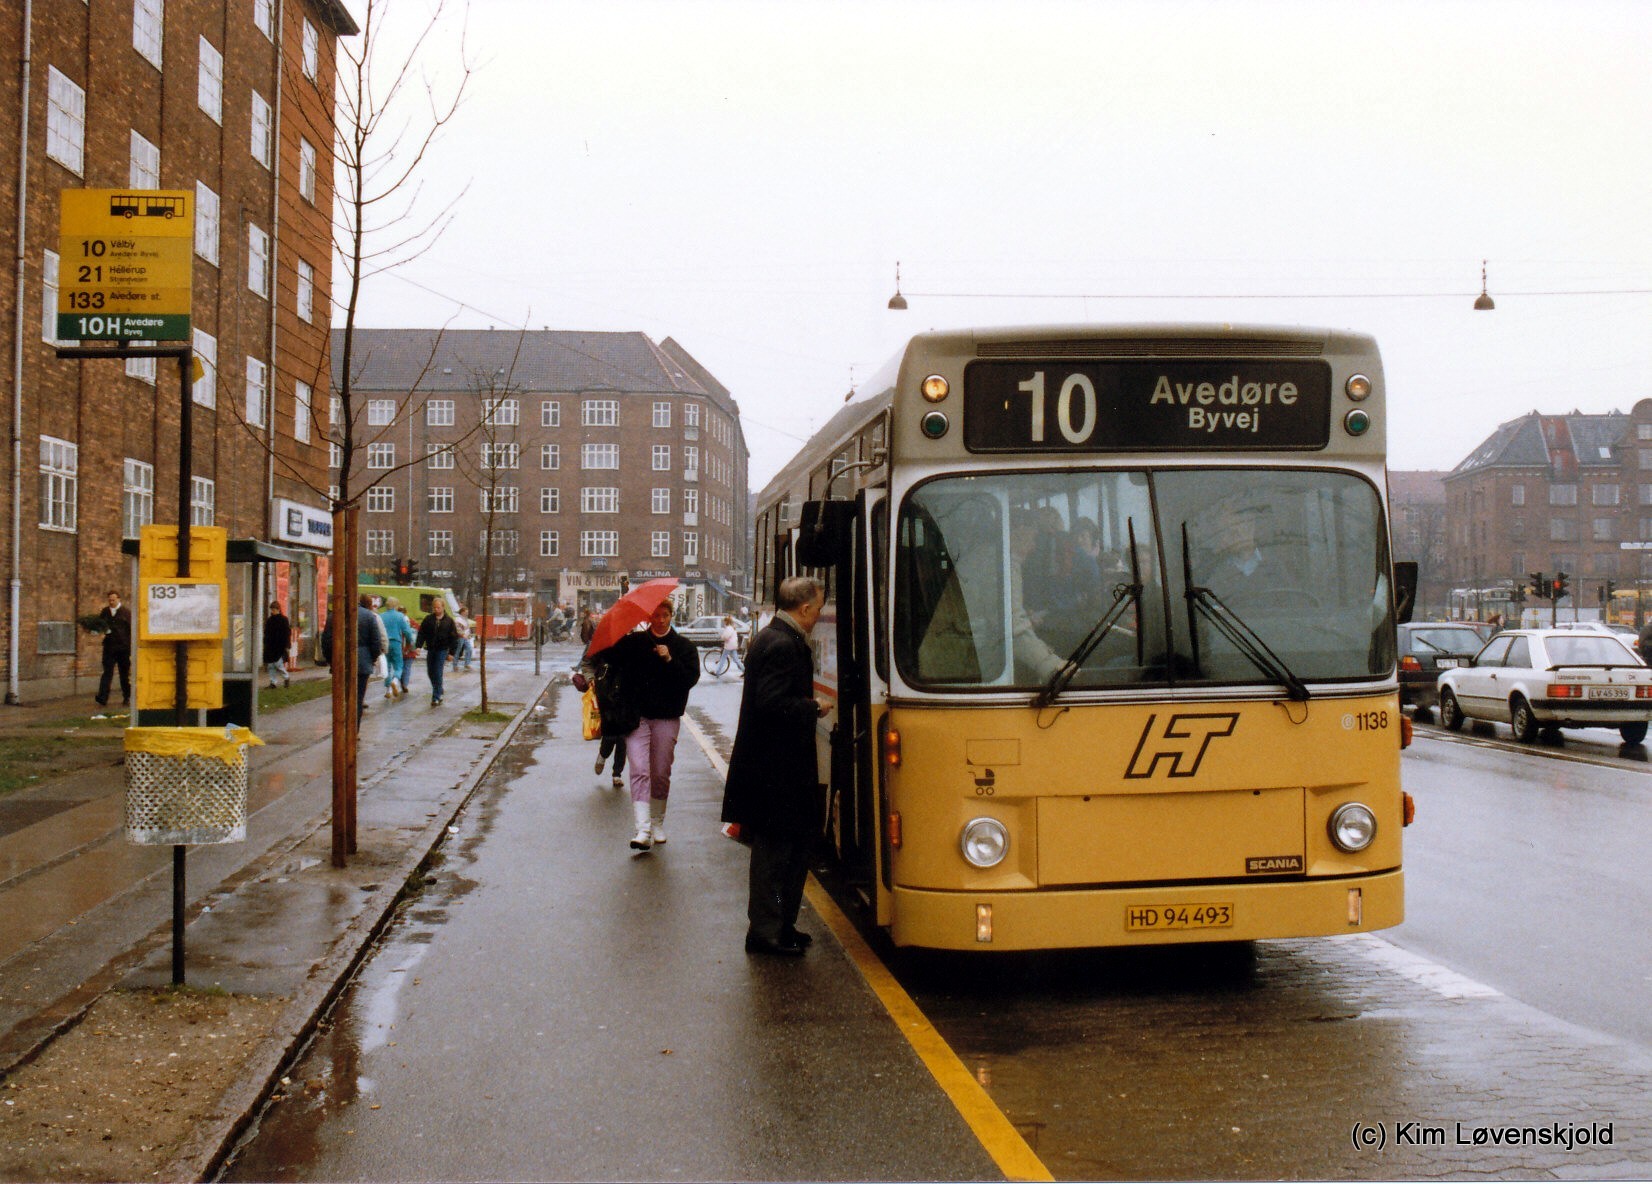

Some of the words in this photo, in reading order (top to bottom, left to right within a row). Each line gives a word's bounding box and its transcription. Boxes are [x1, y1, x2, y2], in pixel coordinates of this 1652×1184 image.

[82, 240, 106, 257] 10
[111, 240, 135, 249] Valby
[78, 265, 102, 282] 21
[110, 266, 146, 275] Hellerup
[69, 292, 105, 309] 133
[110, 291, 146, 300] Avedøre
[79, 317, 121, 335] 10H
[124, 318, 164, 327] Avedøre
[124, 328, 143, 336] Byvej
[1150, 375, 1299, 405] Avedøre
[1018, 371, 1097, 444] 10
[1188, 407, 1260, 432] Byvej
[567, 575, 581, 586] VIN
[585, 575, 592, 586] &
[151, 586, 177, 599] 133
[1356, 711, 1389, 731] 1138
[1124, 712, 1240, 779] HT
[1249, 858, 1300, 871] SCANIA
[1130, 909, 1159, 926] HD
[1164, 907, 1189, 925] 94
[1193, 906, 1230, 924] 493
